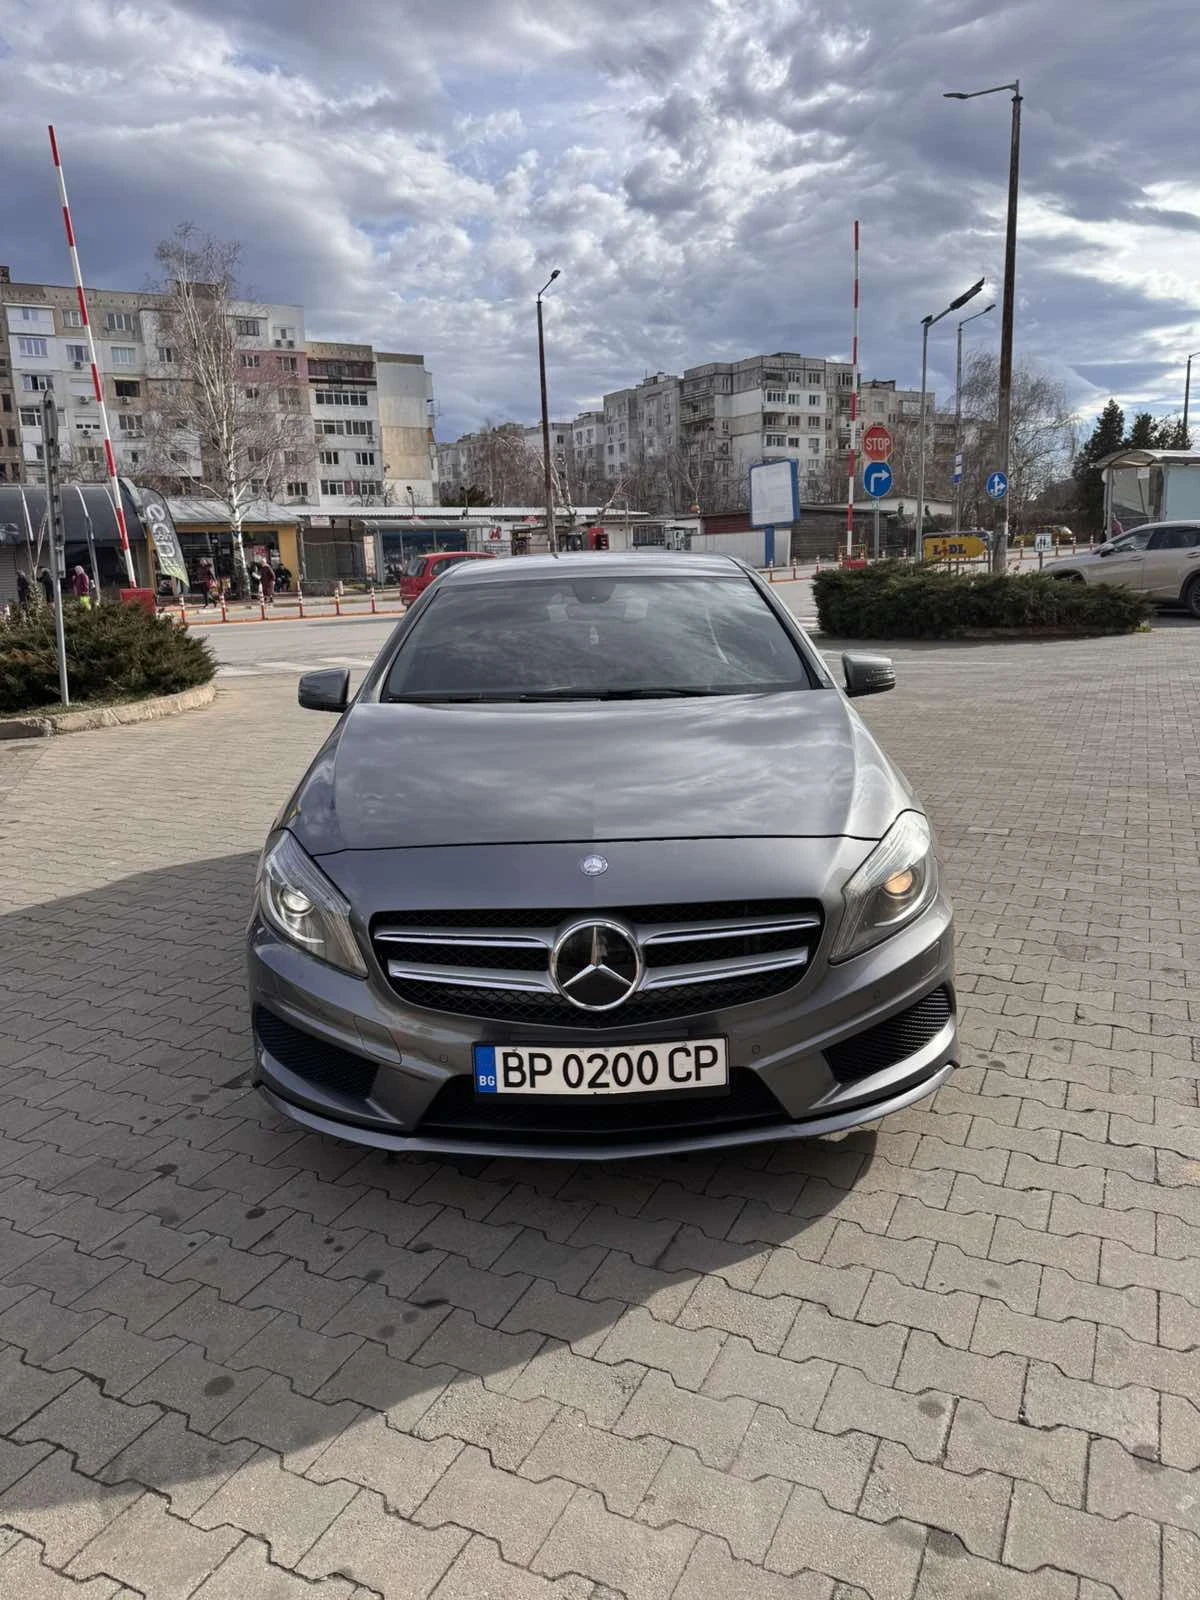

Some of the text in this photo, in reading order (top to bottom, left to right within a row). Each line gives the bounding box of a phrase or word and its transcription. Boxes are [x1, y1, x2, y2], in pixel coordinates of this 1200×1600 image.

[865, 437, 890, 451] STOP
[502, 1045, 719, 1089] BP 0200 CP
[479, 1075, 496, 1086] BG
